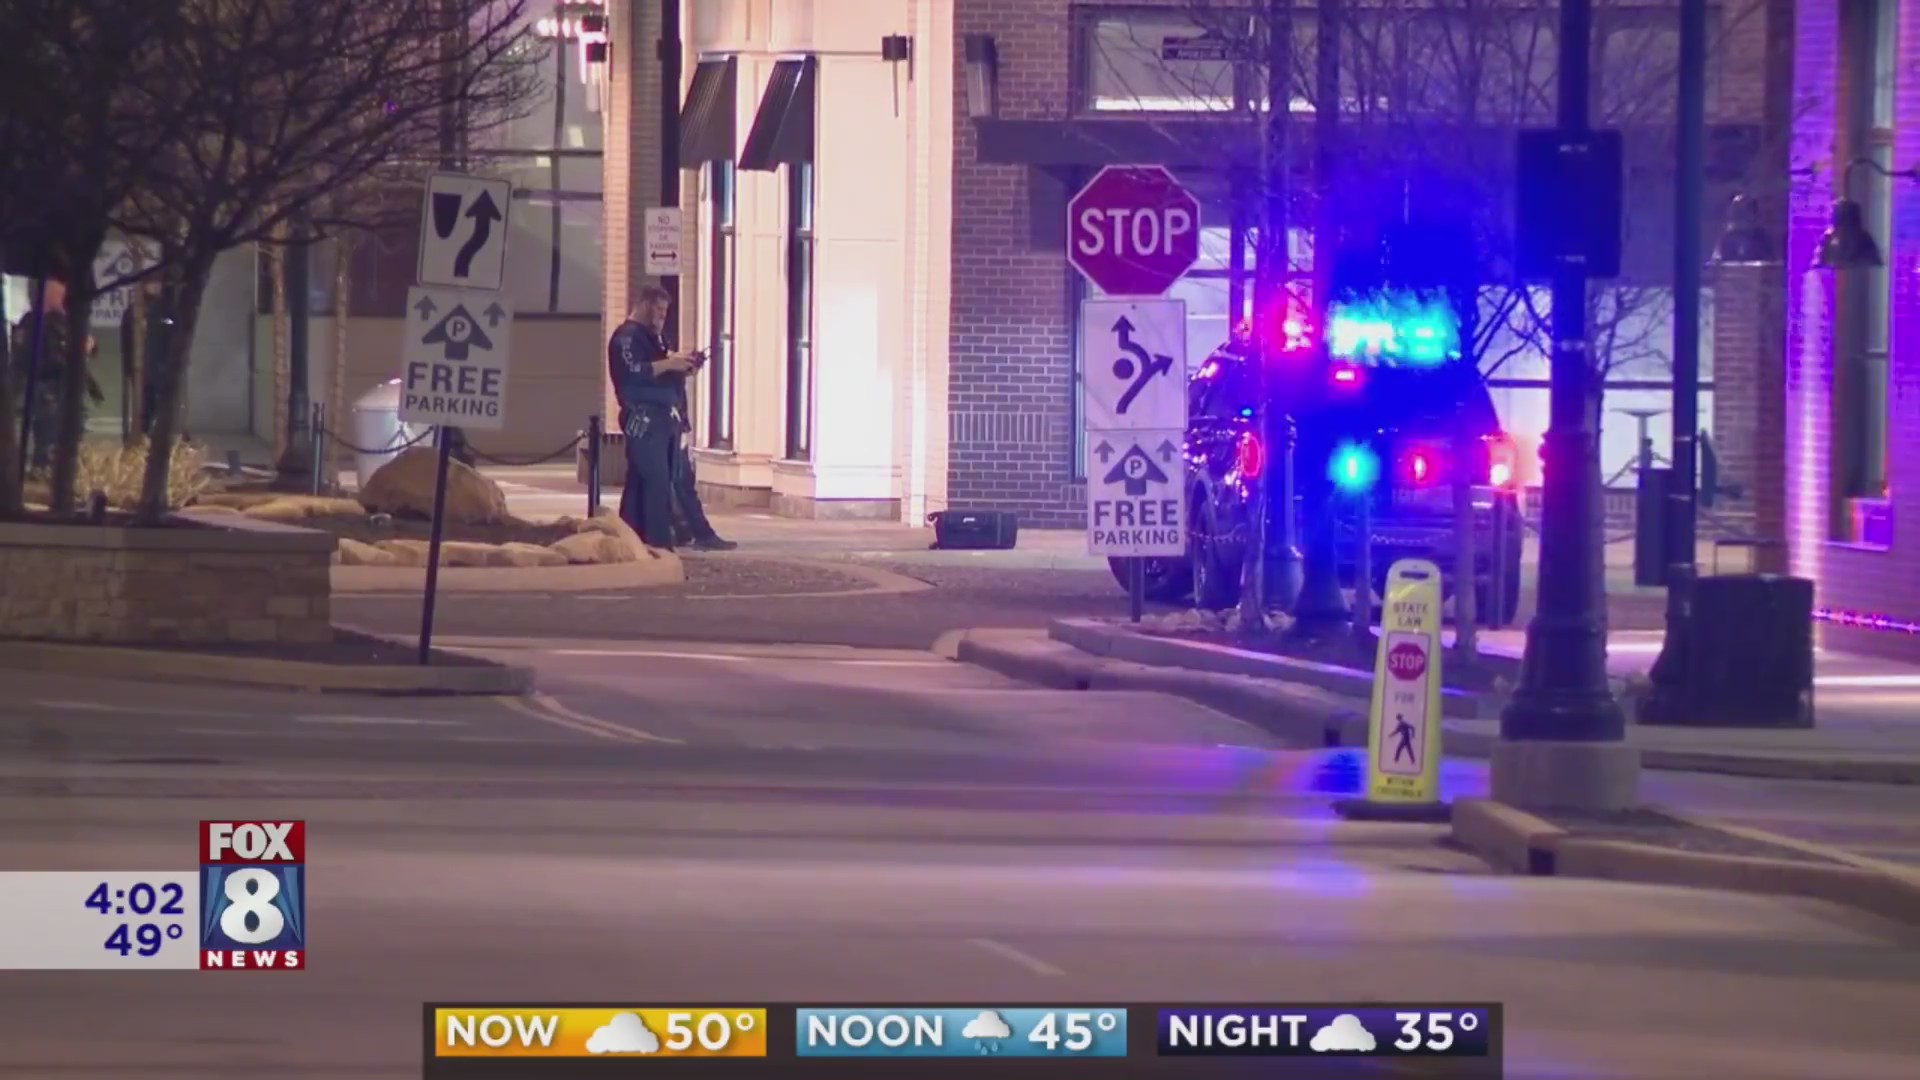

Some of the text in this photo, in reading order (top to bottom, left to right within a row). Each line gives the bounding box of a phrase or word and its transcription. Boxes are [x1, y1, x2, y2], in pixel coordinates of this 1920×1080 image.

[1078, 207, 1191, 256] STOP
[452, 320, 465, 337] P
[407, 361, 501, 397] FREE
[405, 394, 499, 417] PARKING
[1130, 459, 1142, 476] P
[1094, 500, 1179, 526] FREE
[1094, 530, 1179, 545] PARKING
[1392, 602, 1429, 615] STATE
[1397, 616, 1422, 628] LAW
[1390, 653, 1424, 671] STOP
[1394, 691, 1416, 704] FOR
